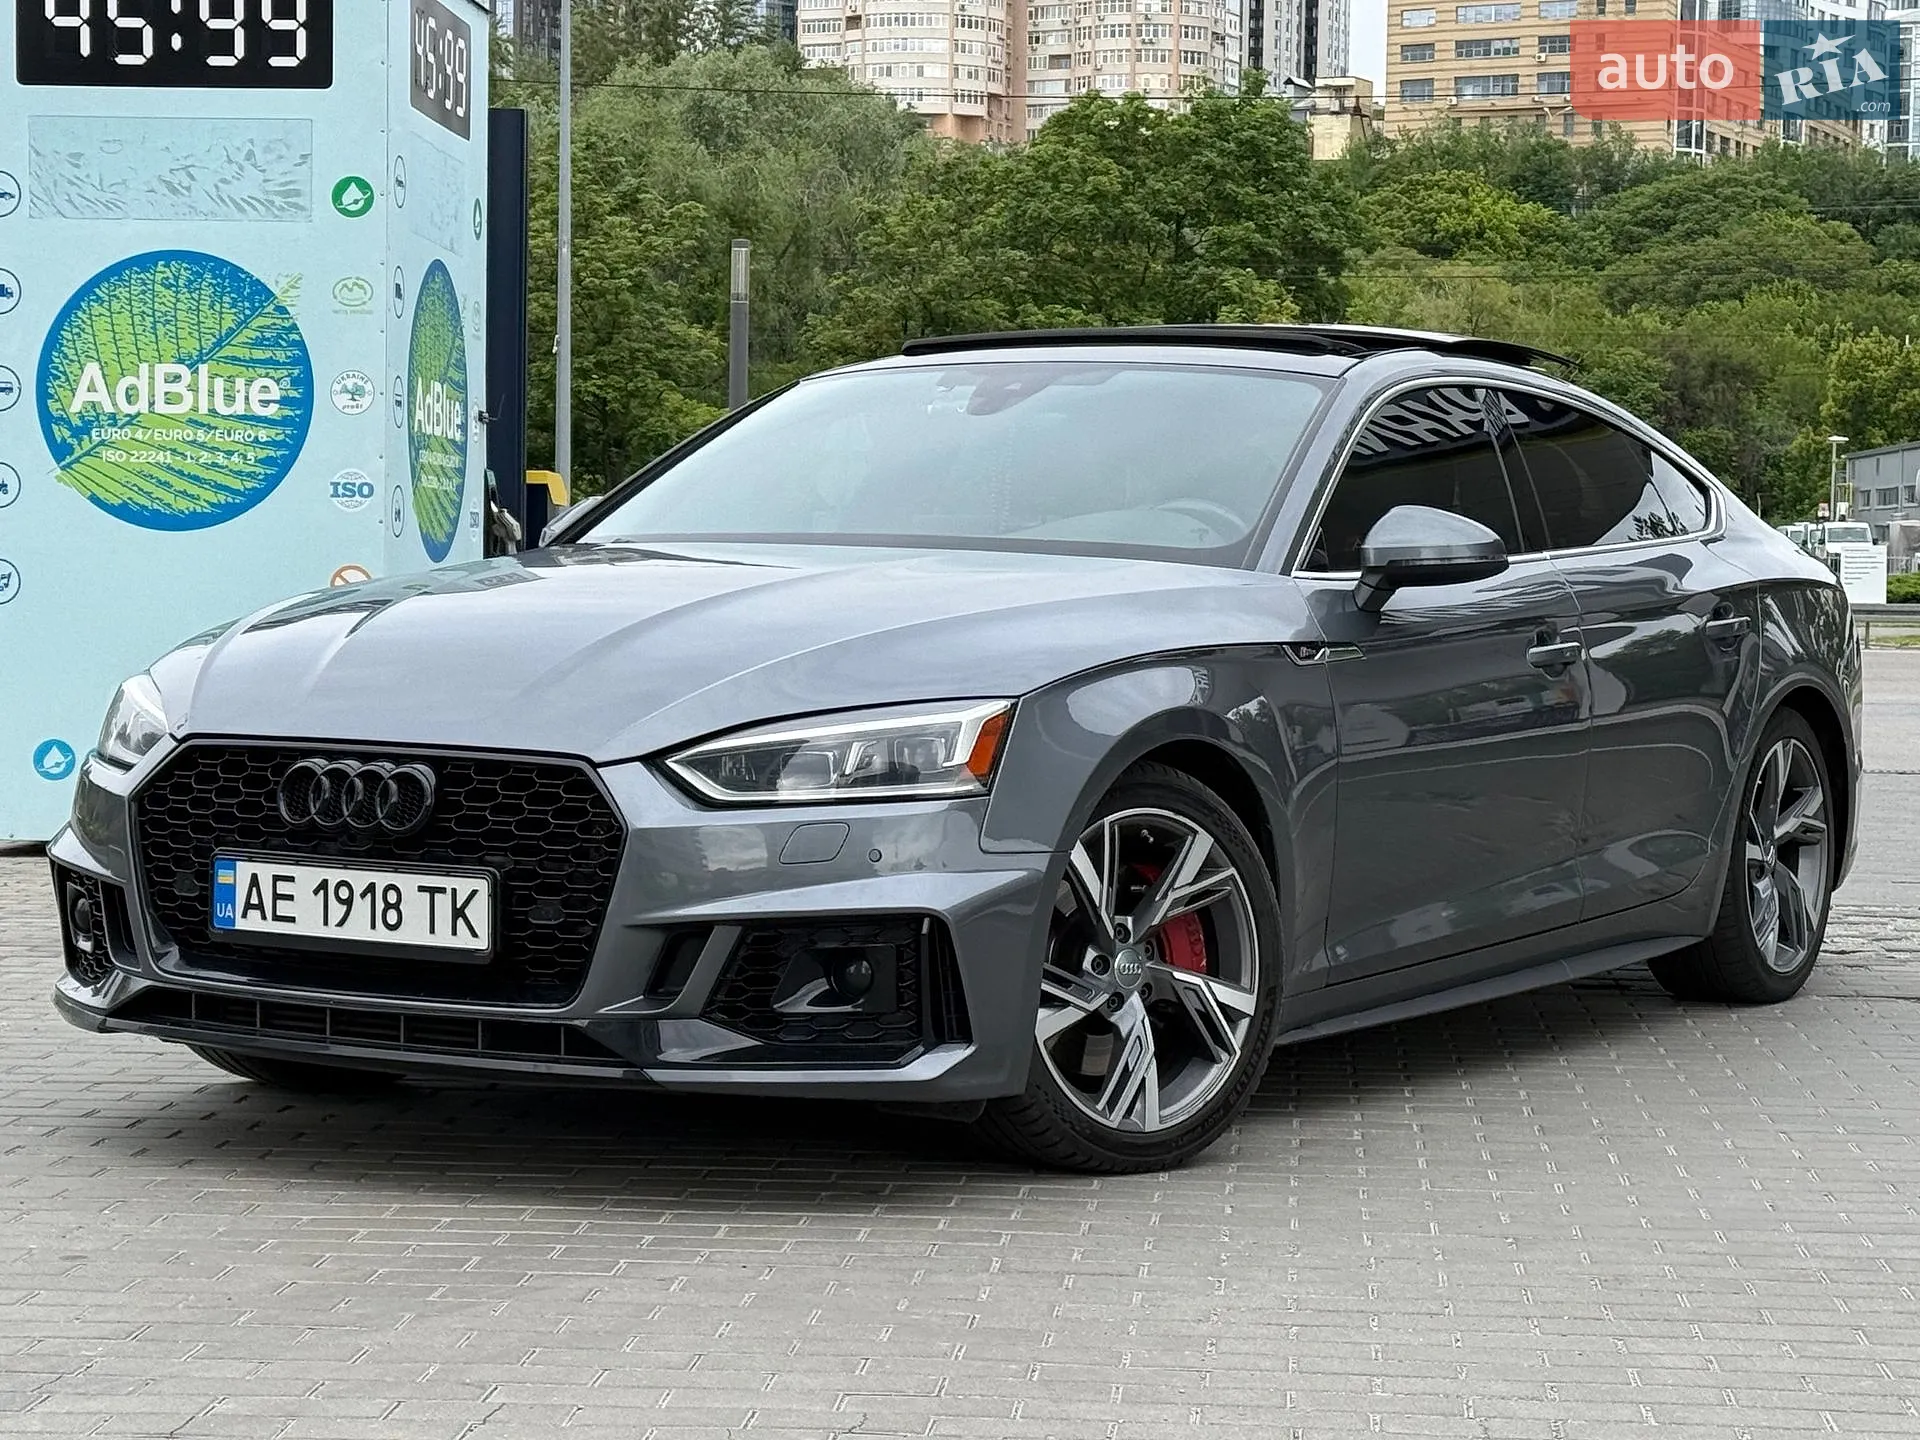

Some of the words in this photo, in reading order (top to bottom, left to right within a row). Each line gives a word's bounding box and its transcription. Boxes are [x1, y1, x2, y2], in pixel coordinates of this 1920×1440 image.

[415, 13, 466, 117] 45:99
[92, 428, 131, 441] EURO
[103, 450, 127, 463] ISO
[129, 450, 173, 463] 22241
[330, 481, 374, 498] ISO
[216, 903, 234, 919] UA
[241, 872, 297, 924] AE
[312, 878, 403, 931] 1918
[417, 885, 480, 938] TK
